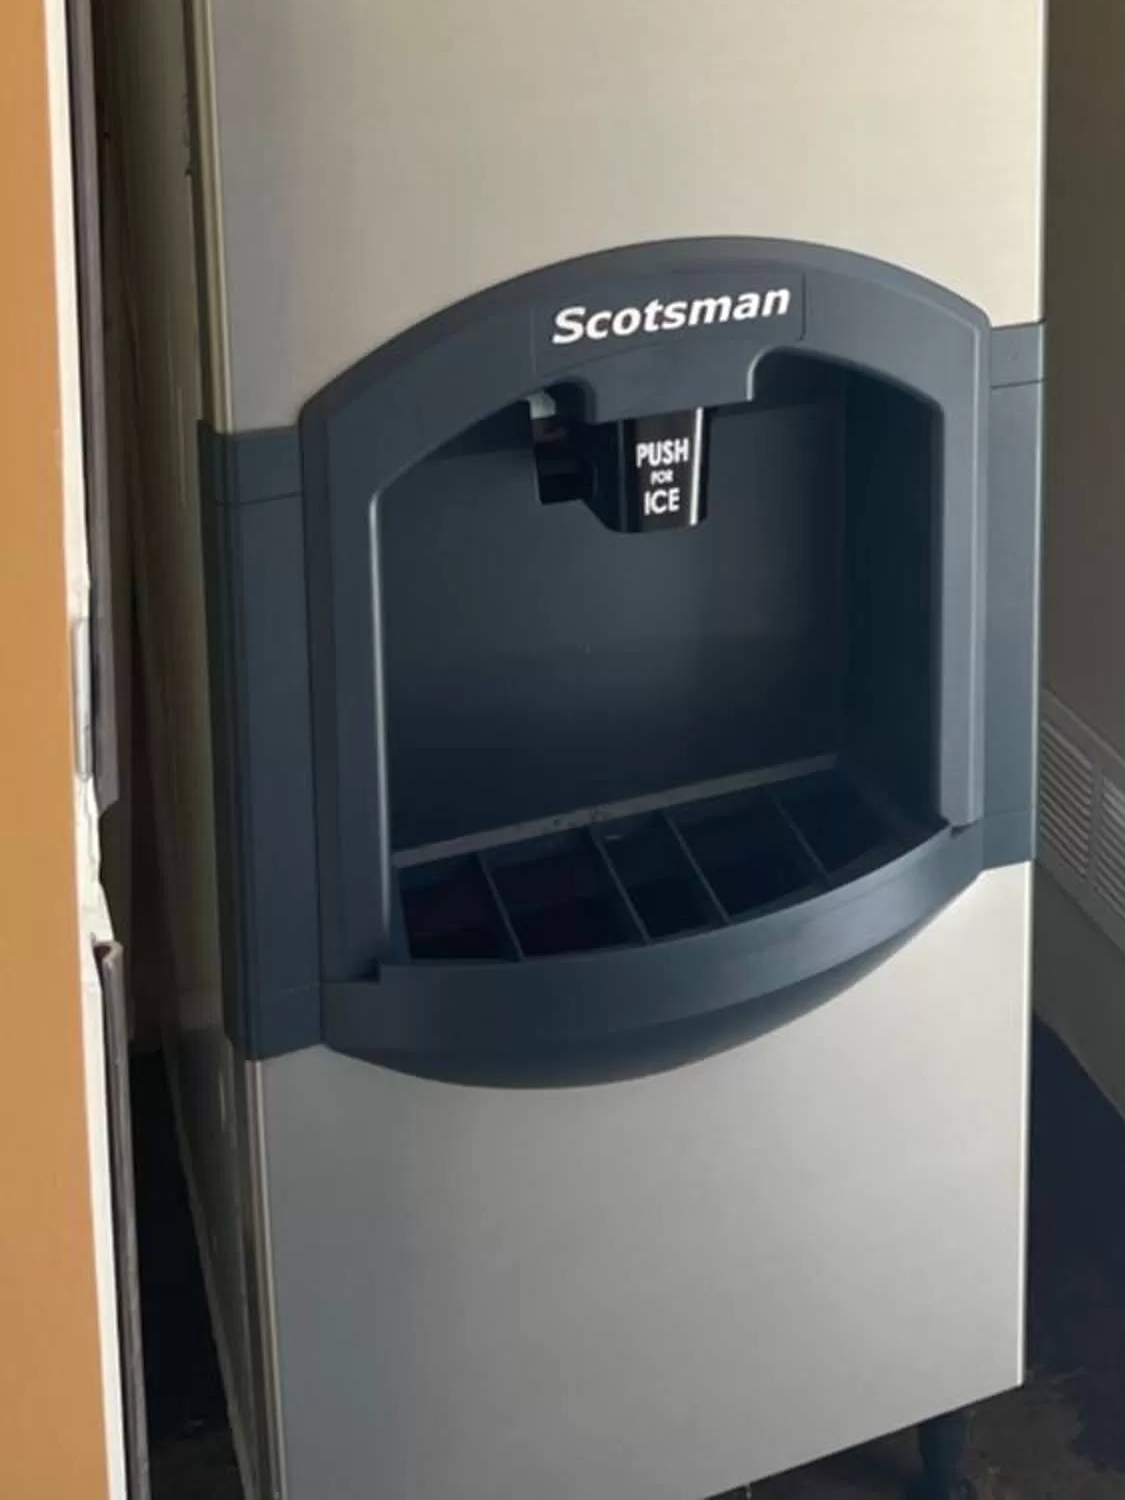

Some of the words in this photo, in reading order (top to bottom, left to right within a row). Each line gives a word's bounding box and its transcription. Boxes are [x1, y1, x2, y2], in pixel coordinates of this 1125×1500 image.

[552, 288, 791, 344] Scotsman
[636, 438, 689, 468] PUSH
[650, 469, 673, 486] FOR
[644, 487, 680, 516] ICE
